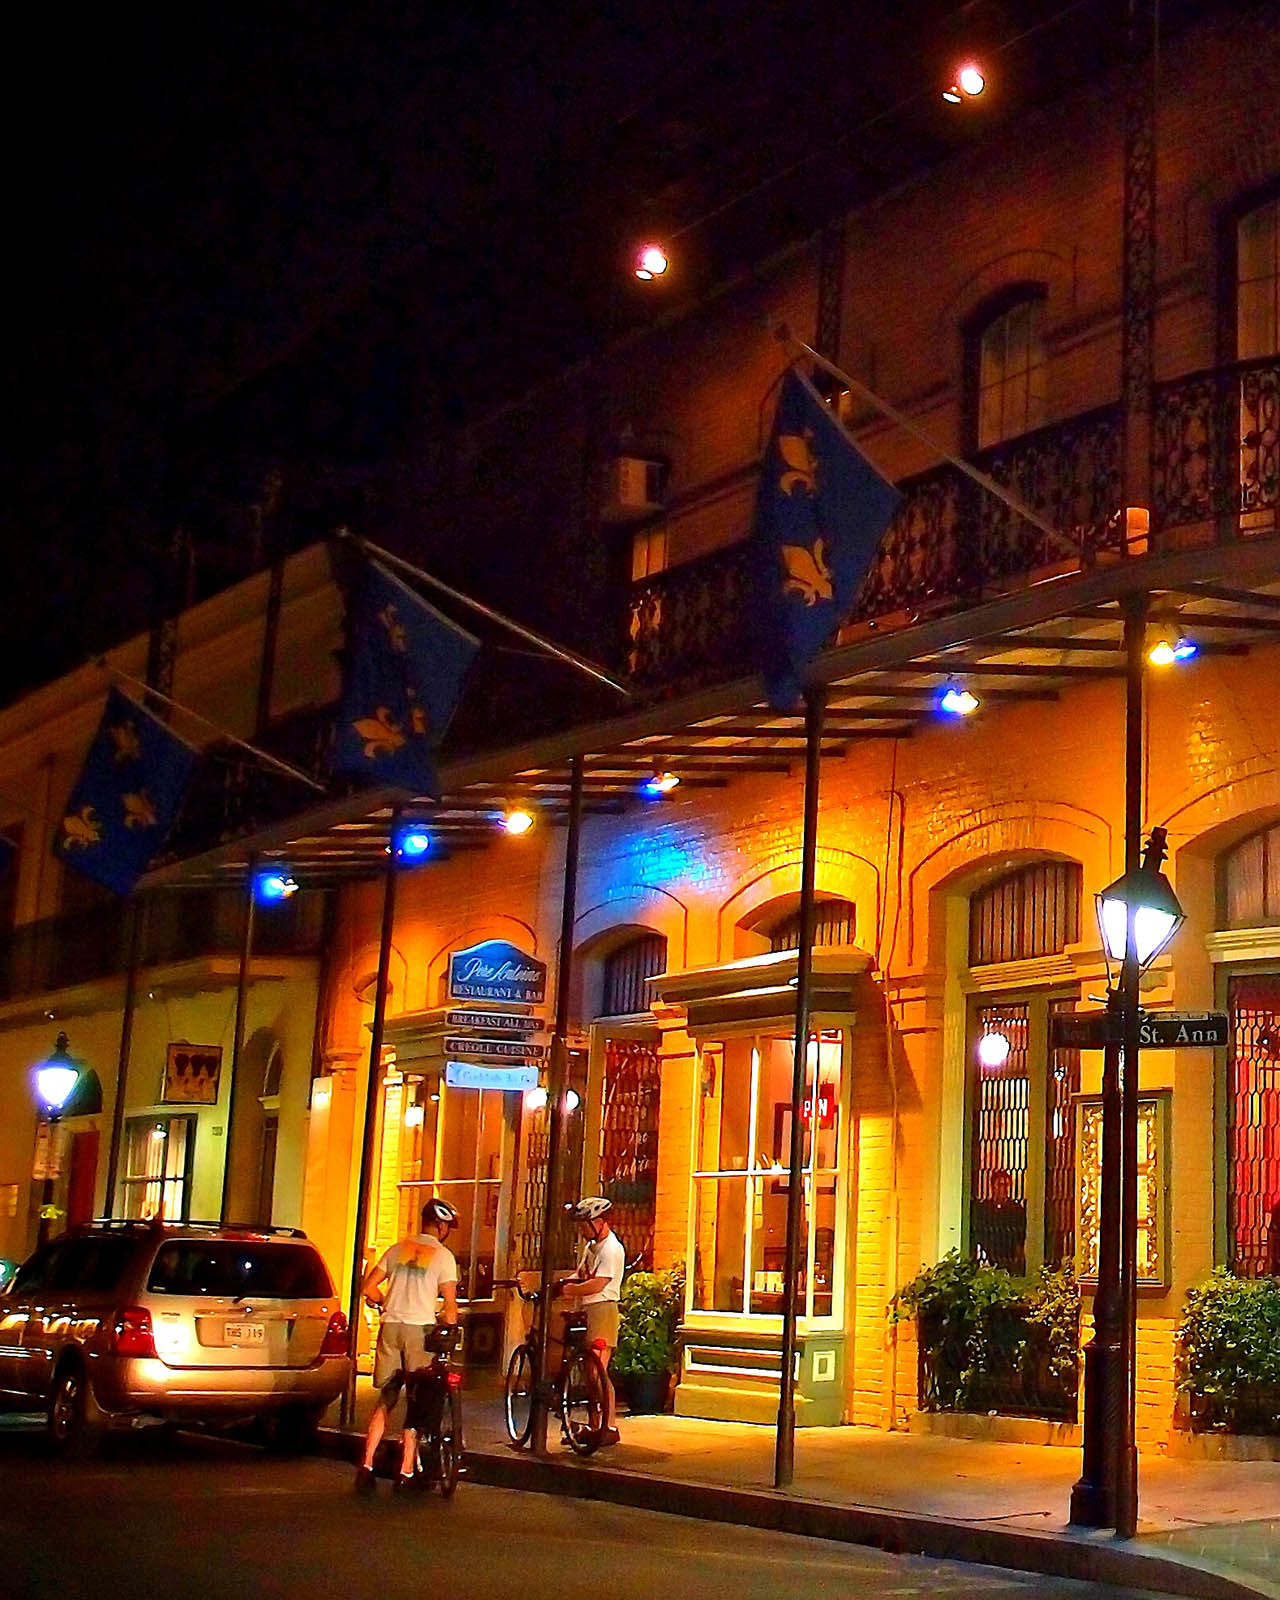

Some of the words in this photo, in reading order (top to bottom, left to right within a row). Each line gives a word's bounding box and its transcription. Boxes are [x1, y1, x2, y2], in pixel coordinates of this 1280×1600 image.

[452, 984, 511, 998] RESTAURANT
[514, 989, 522, 999] &
[525, 990, 543, 1001] BAR
[452, 1014, 500, 1027] BREAKFAST
[503, 1017, 521, 1028] ALL
[1139, 1024, 1164, 1044] St.
[1175, 1024, 1218, 1043] Ann
[449, 1041, 492, 1053] CREOLE
[496, 1044, 540, 1056] CUISINE
